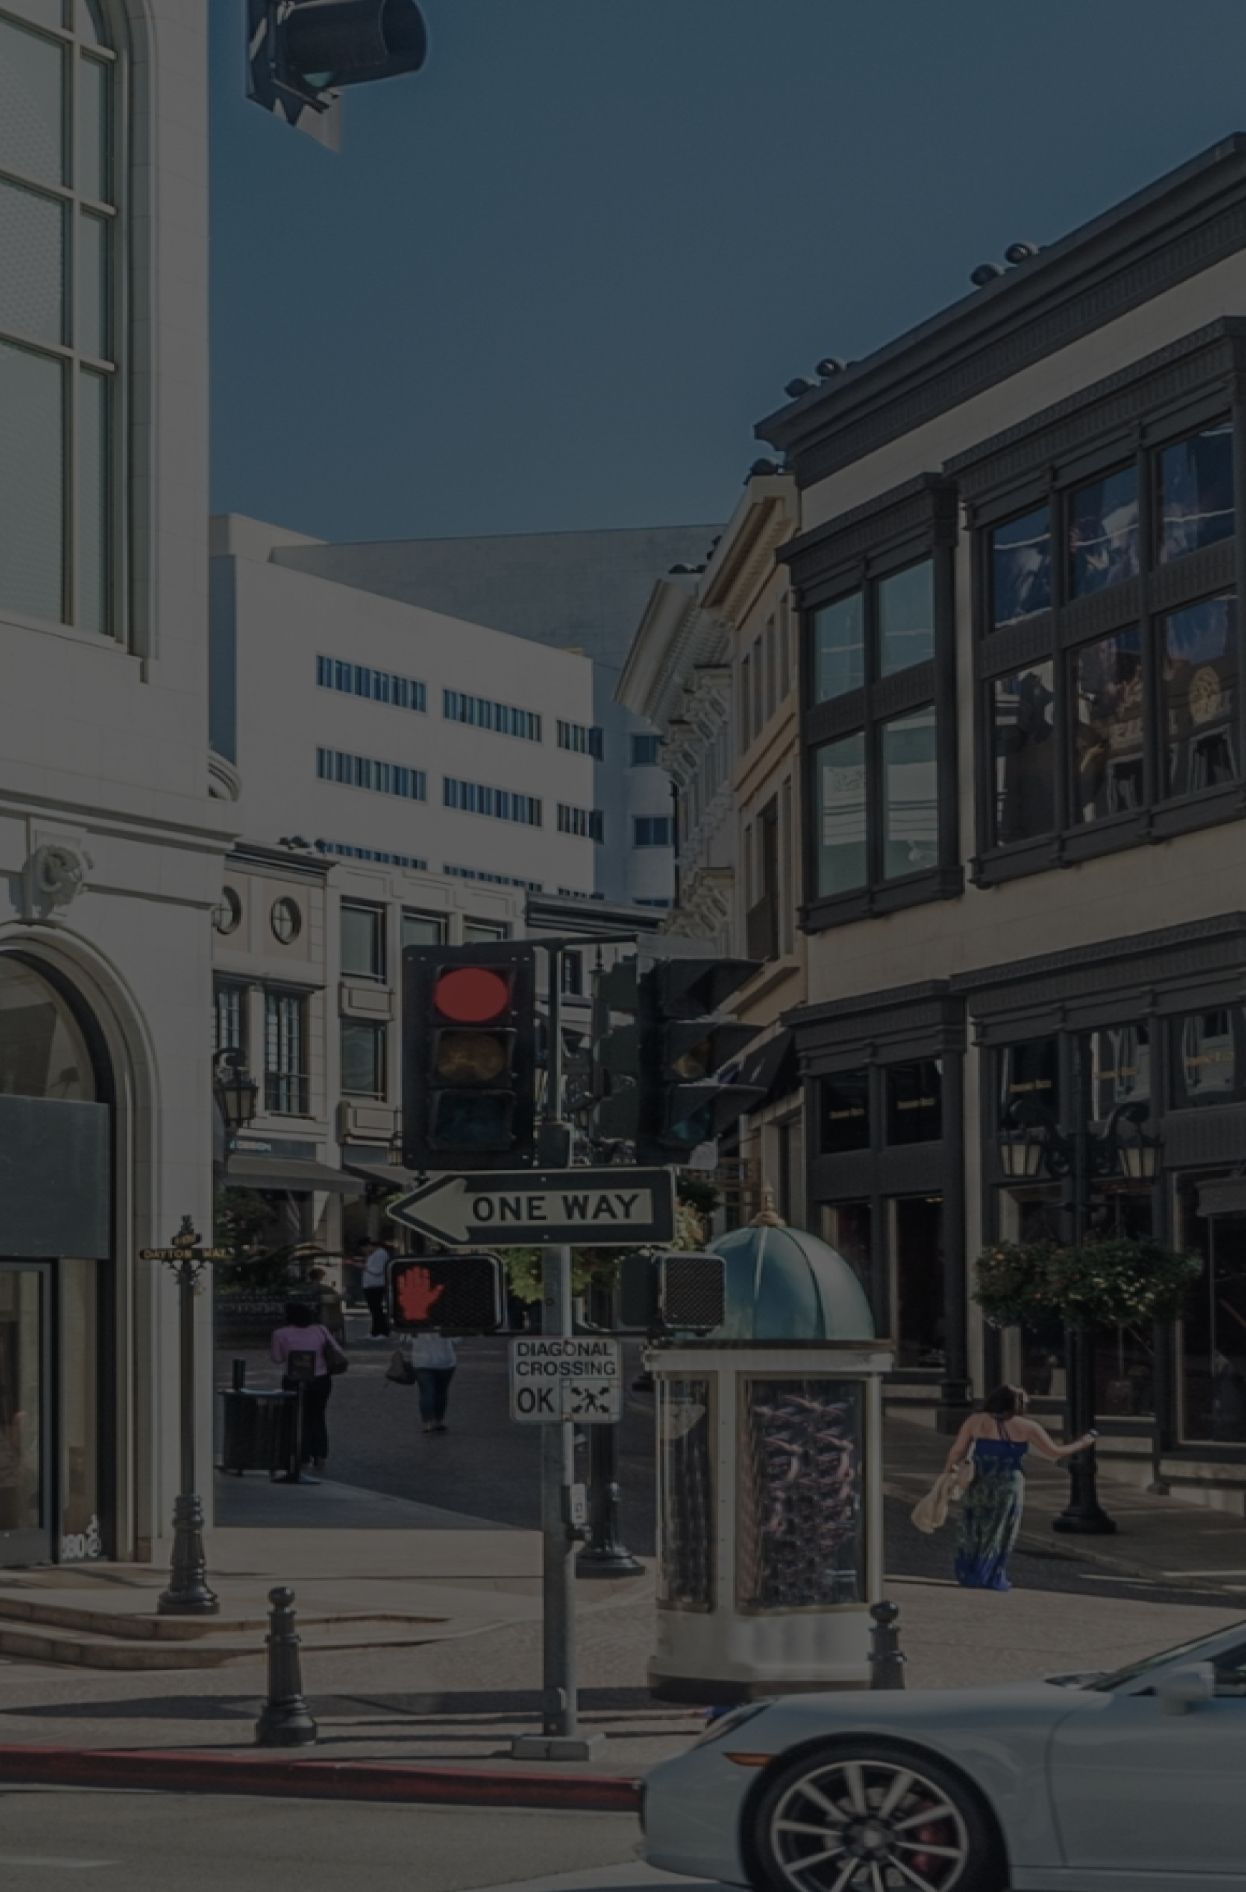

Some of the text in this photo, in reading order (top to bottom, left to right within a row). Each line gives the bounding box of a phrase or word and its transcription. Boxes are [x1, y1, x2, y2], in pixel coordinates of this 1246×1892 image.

[472, 1194, 639, 1221] ONE WAY
[143, 1248, 192, 1259] DAYTON
[517, 1341, 612, 1357] DIAGONAL
[516, 1361, 616, 1376] CROSSING
[517, 1387, 555, 1413] OK
